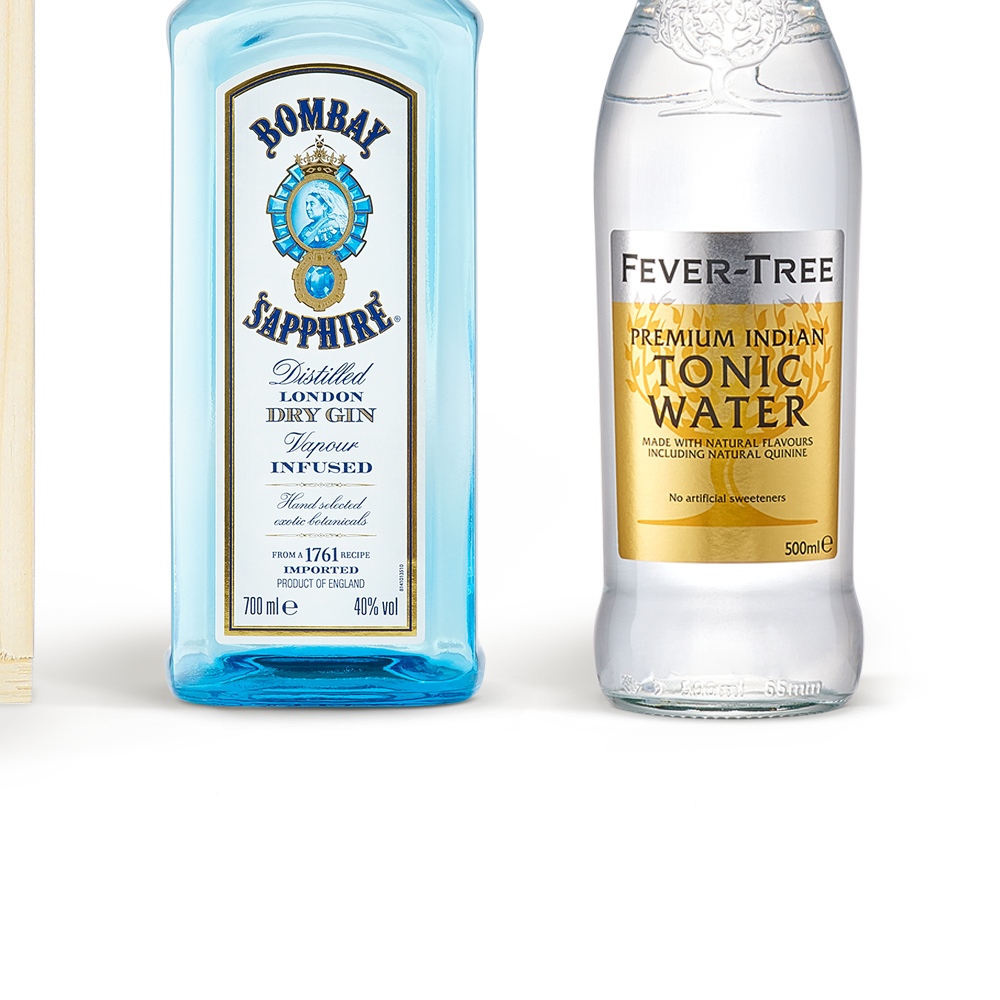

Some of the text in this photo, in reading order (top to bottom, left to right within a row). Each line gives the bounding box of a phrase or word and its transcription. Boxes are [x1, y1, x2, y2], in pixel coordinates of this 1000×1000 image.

[249, 97, 391, 159] BOMBAY
[622, 253, 833, 284] FEVER-TREE
[631, 327, 825, 347] PREMIUM INDIAN
[268, 358, 375, 386] Distilled
[653, 354, 803, 389] TONIC
[278, 391, 364, 403] LONDON
[265, 407, 377, 423] DRY GIN
[647, 394, 810, 430] WATER
[283, 431, 360, 459] Vapour
[642, 437, 813, 448] MADE WITH NATURAL FLAVOURS
[648, 448, 808, 460] INCLUDING NATURAL QUININE
[270, 461, 373, 474] INFUSED
[276, 491, 368, 510] Hand selected
[669, 493, 787, 503] No artificial sweeteners
[273, 511, 371, 526] exotic botanicals
[272, 547, 371, 562] FROM A 1761 RECIPE
[785, 541, 820, 556] 500ml
[283, 566, 359, 574] IMPORTED
[276, 578, 366, 589] PRODUCT OF ENGLAND
[243, 597, 263, 616] 700
[266, 596, 279, 615] ml
[353, 597, 398, 616] 40% vol
